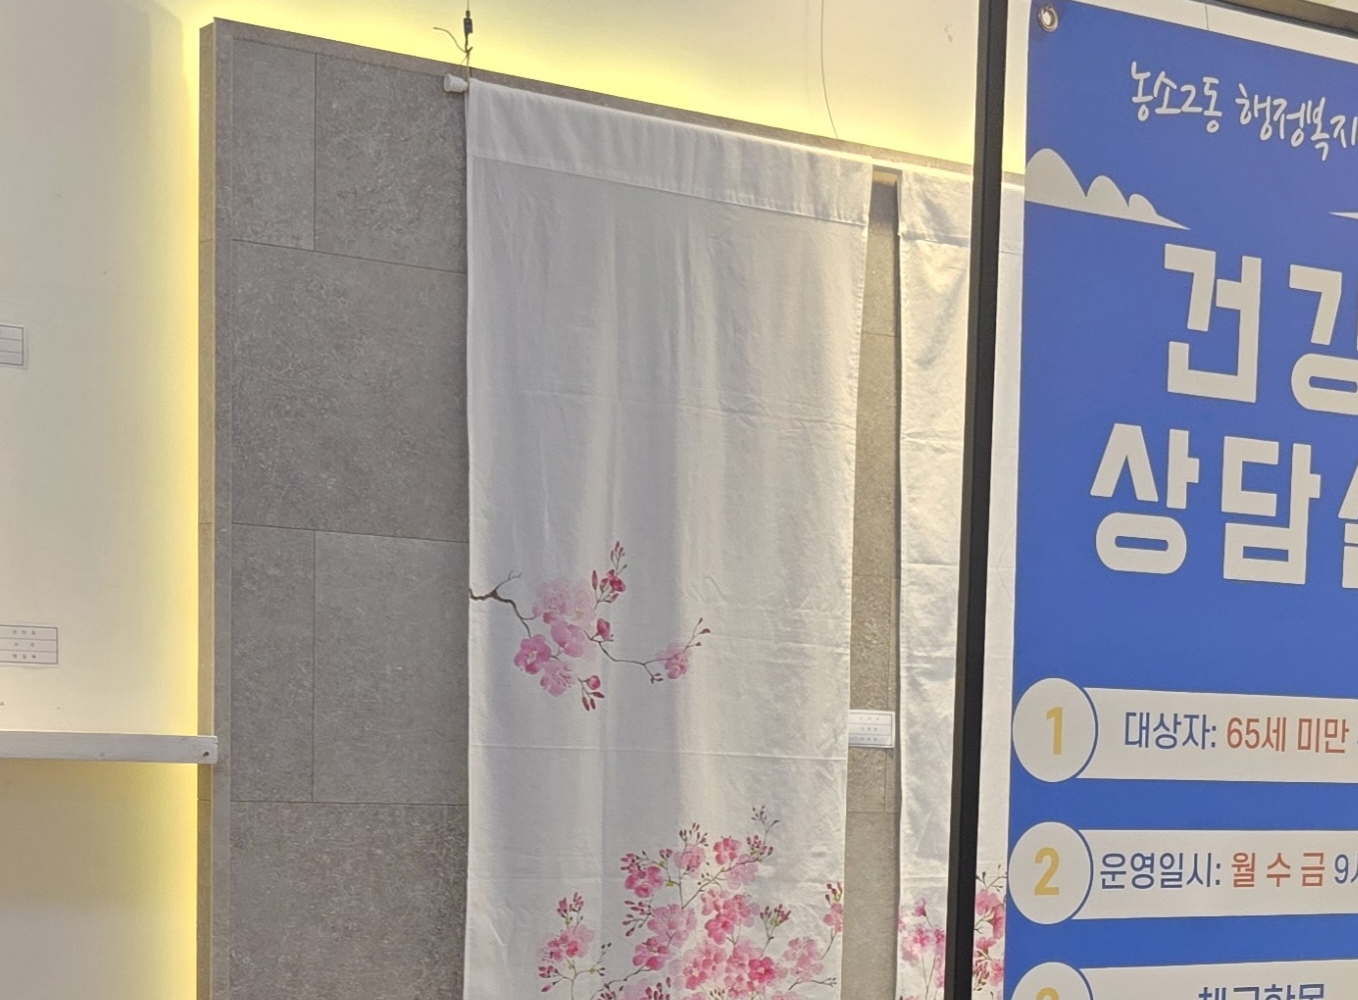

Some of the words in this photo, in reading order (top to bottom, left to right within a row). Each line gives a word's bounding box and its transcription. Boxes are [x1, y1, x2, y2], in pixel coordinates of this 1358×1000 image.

[1131, 61, 1222, 133] 농소2동
[1045, 706, 1065, 755] 1
[1124, 710, 1218, 751] 대상자:
[1226, 716, 1287, 752] 65세
[1298, 717, 1349, 754] 미만
[1033, 847, 1061, 896] 2
[1099, 852, 1222, 889] 운영일시:
[1231, 852, 1257, 888] 월
[1265, 856, 1292, 887] 수
[1300, 853, 1326, 886] 금
